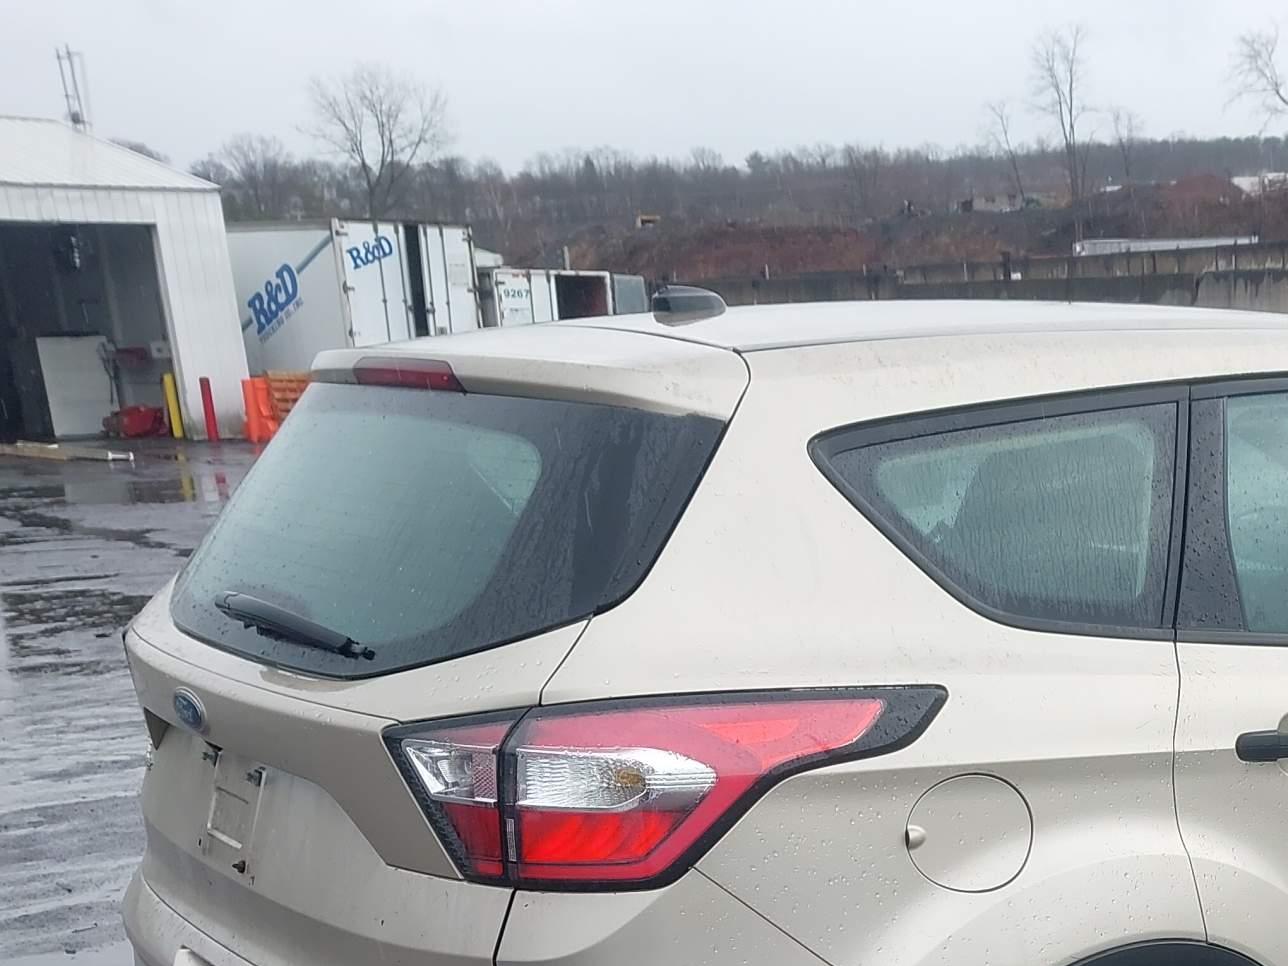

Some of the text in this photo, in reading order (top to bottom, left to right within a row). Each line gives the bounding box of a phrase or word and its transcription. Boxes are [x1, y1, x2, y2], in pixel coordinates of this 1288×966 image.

[346, 236, 393, 270] R&D
[247, 263, 298, 336] R&D
[503, 288, 530, 299] 9267
